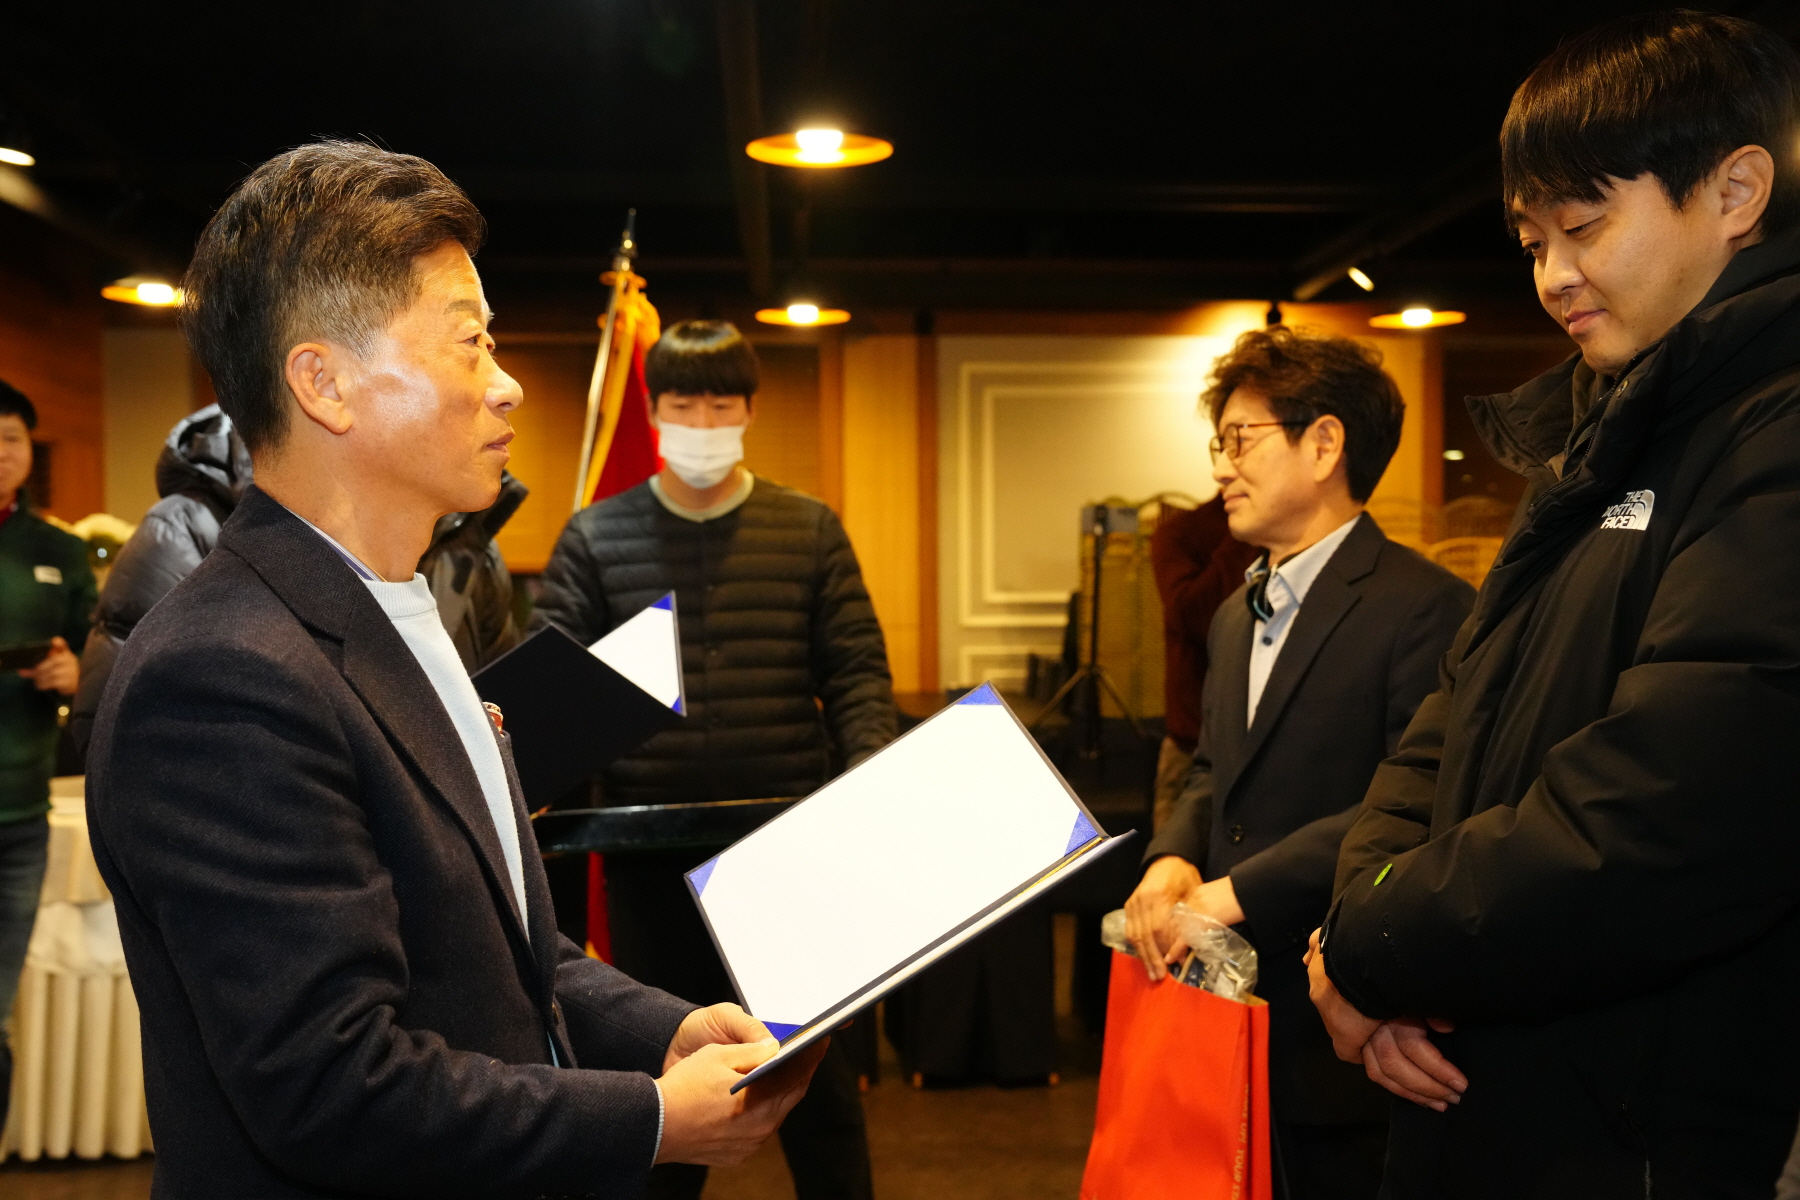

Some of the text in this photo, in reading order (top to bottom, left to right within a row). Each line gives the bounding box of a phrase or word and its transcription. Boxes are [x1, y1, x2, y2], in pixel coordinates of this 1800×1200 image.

[1623, 490, 1645, 503] THE
[1601, 503, 1636, 517] NORTH
[1600, 515, 1631, 529] FACE
